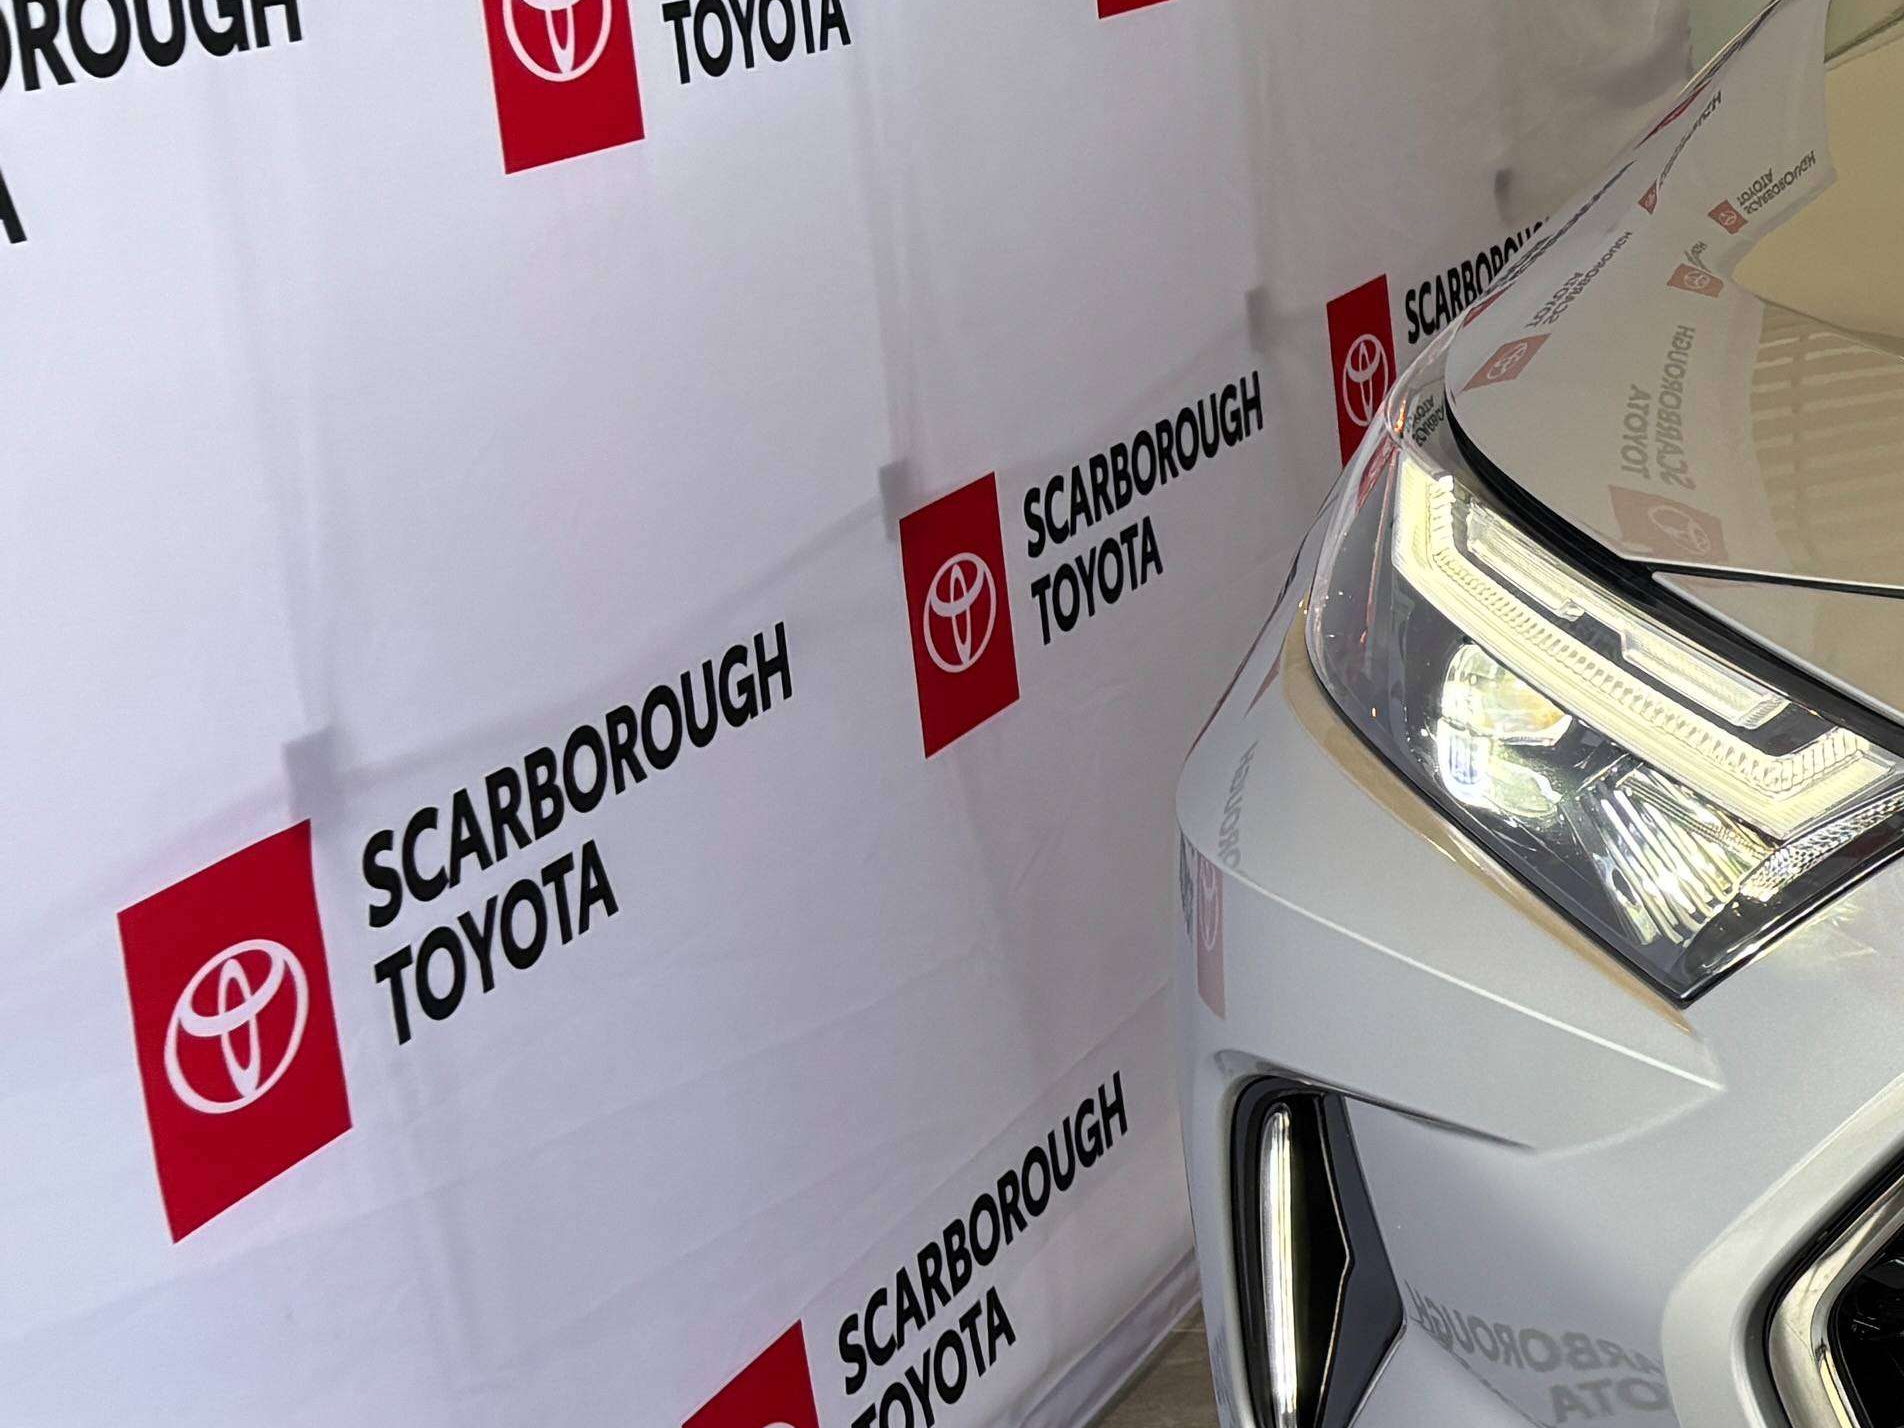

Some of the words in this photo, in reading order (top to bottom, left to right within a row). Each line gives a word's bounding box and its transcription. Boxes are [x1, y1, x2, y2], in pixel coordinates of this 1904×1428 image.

[1023, 370, 1263, 558] SCARBOROUGH
[1031, 515, 1163, 645] TOYOTA
[362, 621, 793, 929] SCARBOROUGH
[374, 839, 619, 1045] TOYOTA
[838, 1070, 1127, 1395] SCARBOROUGH
